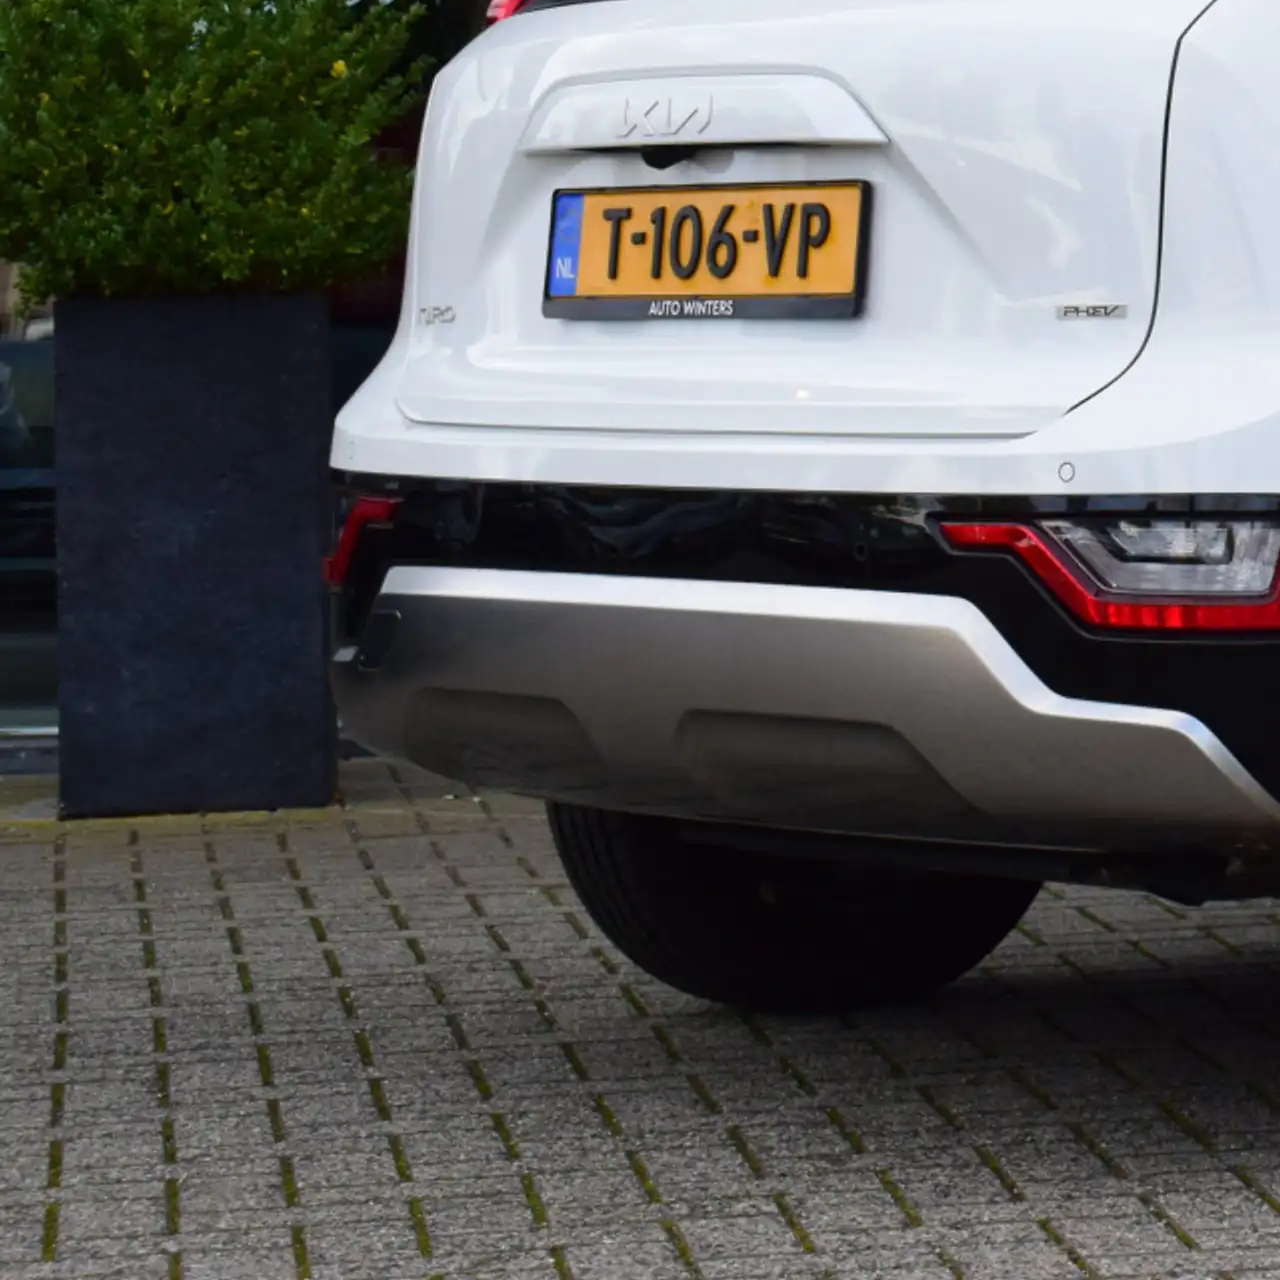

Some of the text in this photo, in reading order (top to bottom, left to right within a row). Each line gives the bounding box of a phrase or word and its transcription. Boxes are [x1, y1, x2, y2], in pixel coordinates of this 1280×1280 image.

[602, 202, 832, 280] T-106-VP
[556, 256, 576, 279] NL
[648, 299, 734, 316] AUTO WINTERS
[1063, 304, 1120, 317] PHEV
